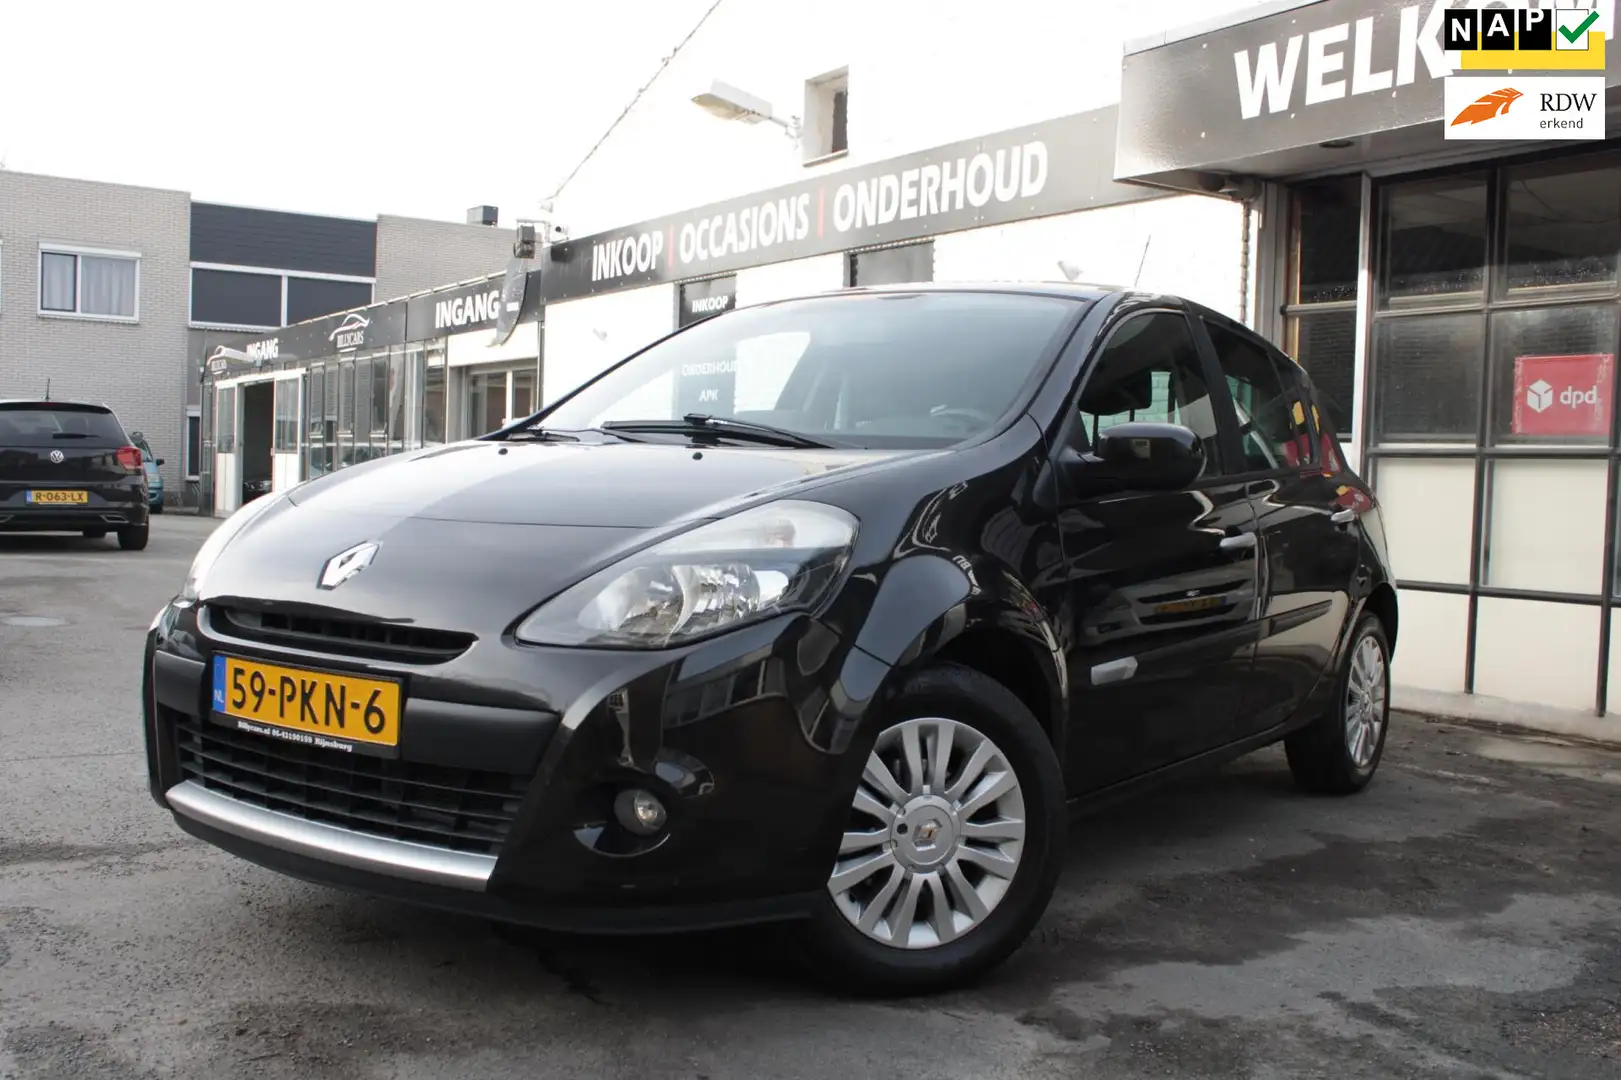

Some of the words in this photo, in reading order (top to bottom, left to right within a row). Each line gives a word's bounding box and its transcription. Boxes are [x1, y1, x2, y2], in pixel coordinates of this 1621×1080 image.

[591, 229, 663, 282] INKOOP
[678, 192, 810, 264] OCCASIONS
[832, 140, 1048, 233] ONDERHOUD
[435, 290, 501, 329] INGANG
[692, 295, 728, 313] INKOOP
[1559, 384, 1598, 410] dpd
[35, 492, 84, 502] R-063-LX
[232, 667, 386, 735] 59-PKN-6
